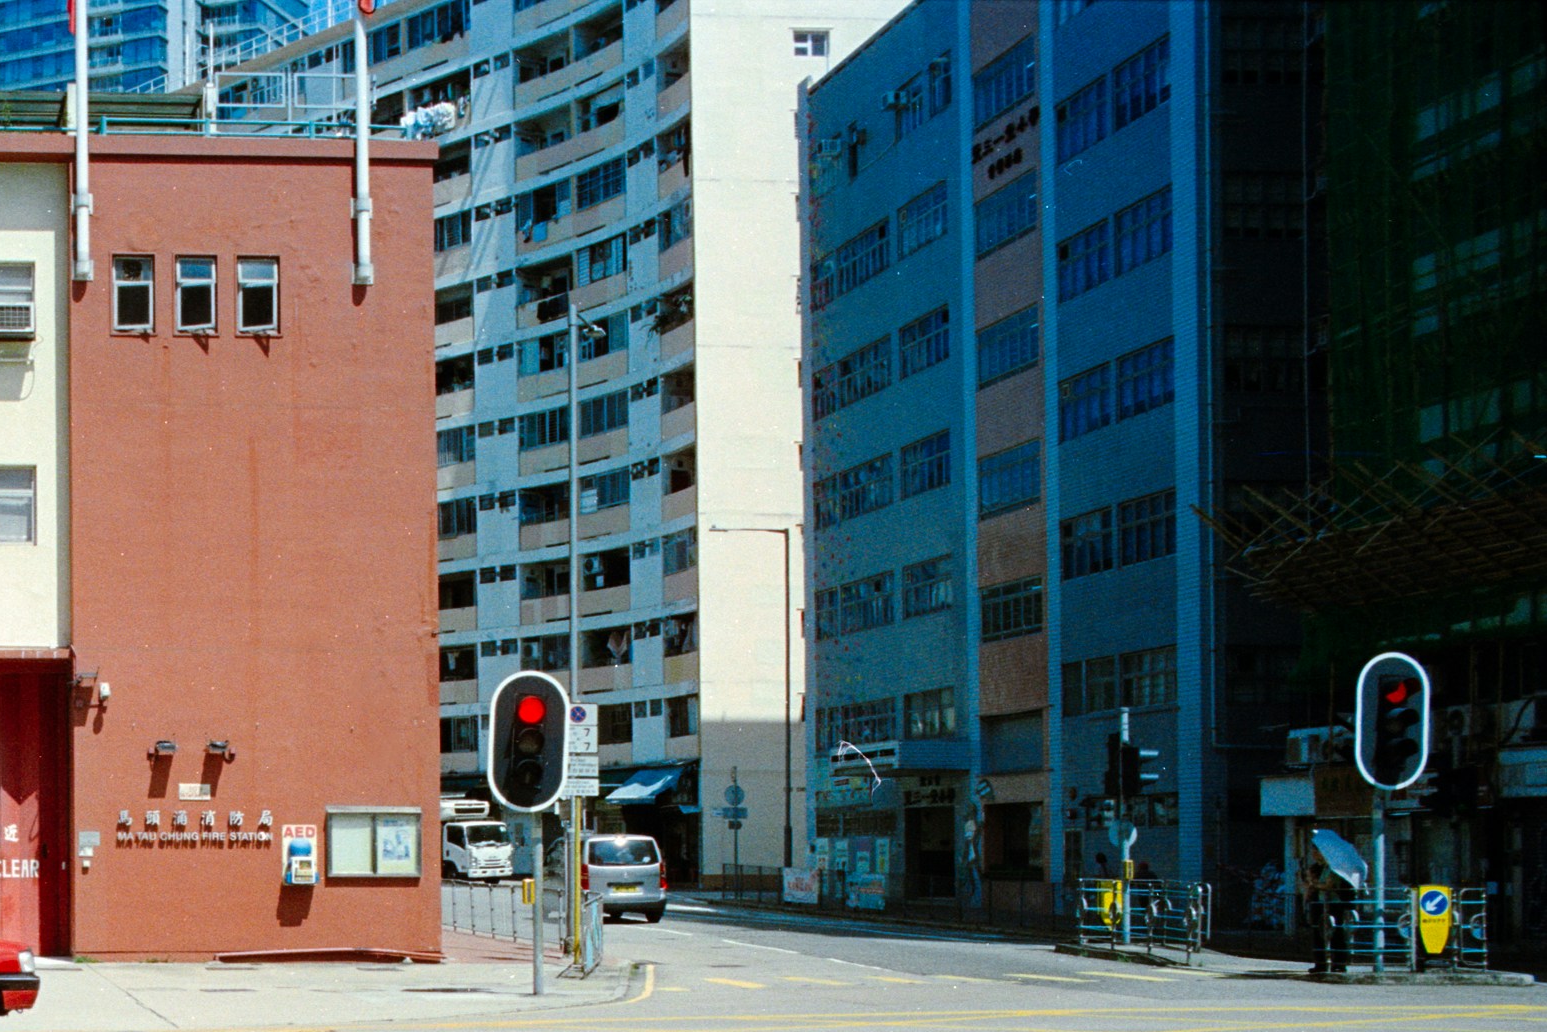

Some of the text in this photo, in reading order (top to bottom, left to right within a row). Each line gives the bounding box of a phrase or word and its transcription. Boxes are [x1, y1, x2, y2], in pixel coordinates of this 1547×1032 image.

[117, 809, 274, 826] 馬頭涌消防局
[117, 832, 273, 841] MA TAU CHUNG FIRE STATION
[283, 826, 316, 838] AED
